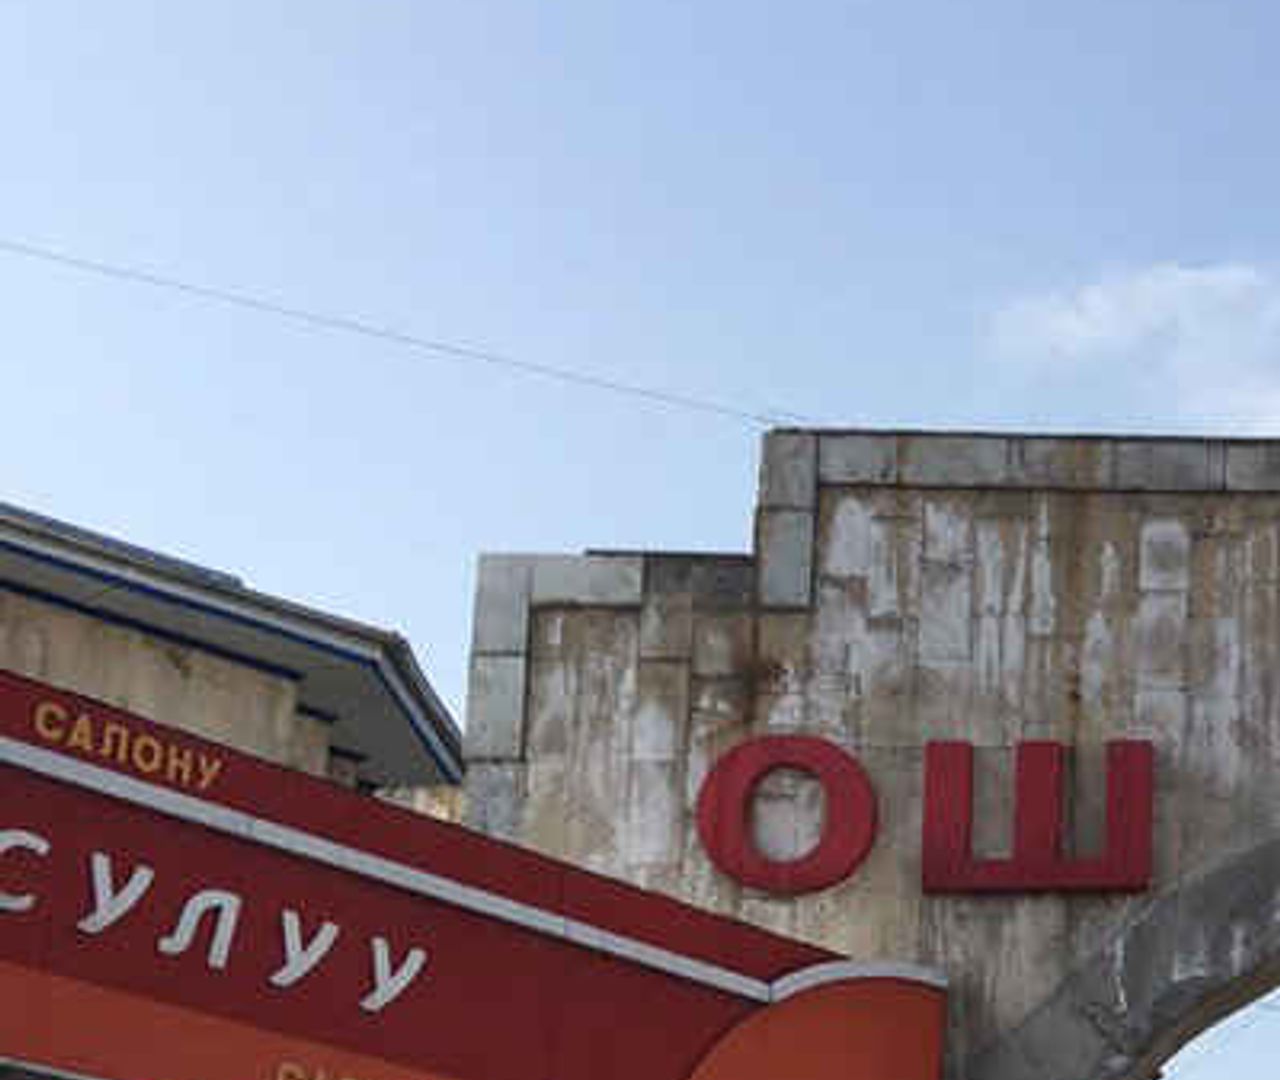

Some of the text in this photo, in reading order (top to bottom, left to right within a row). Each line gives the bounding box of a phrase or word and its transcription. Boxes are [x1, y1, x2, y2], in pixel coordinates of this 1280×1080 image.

[33, 700, 225, 790] САЛОНУ
[697, 734, 1153, 899] ОШ
[0, 828, 427, 1012] СУЛУУ
